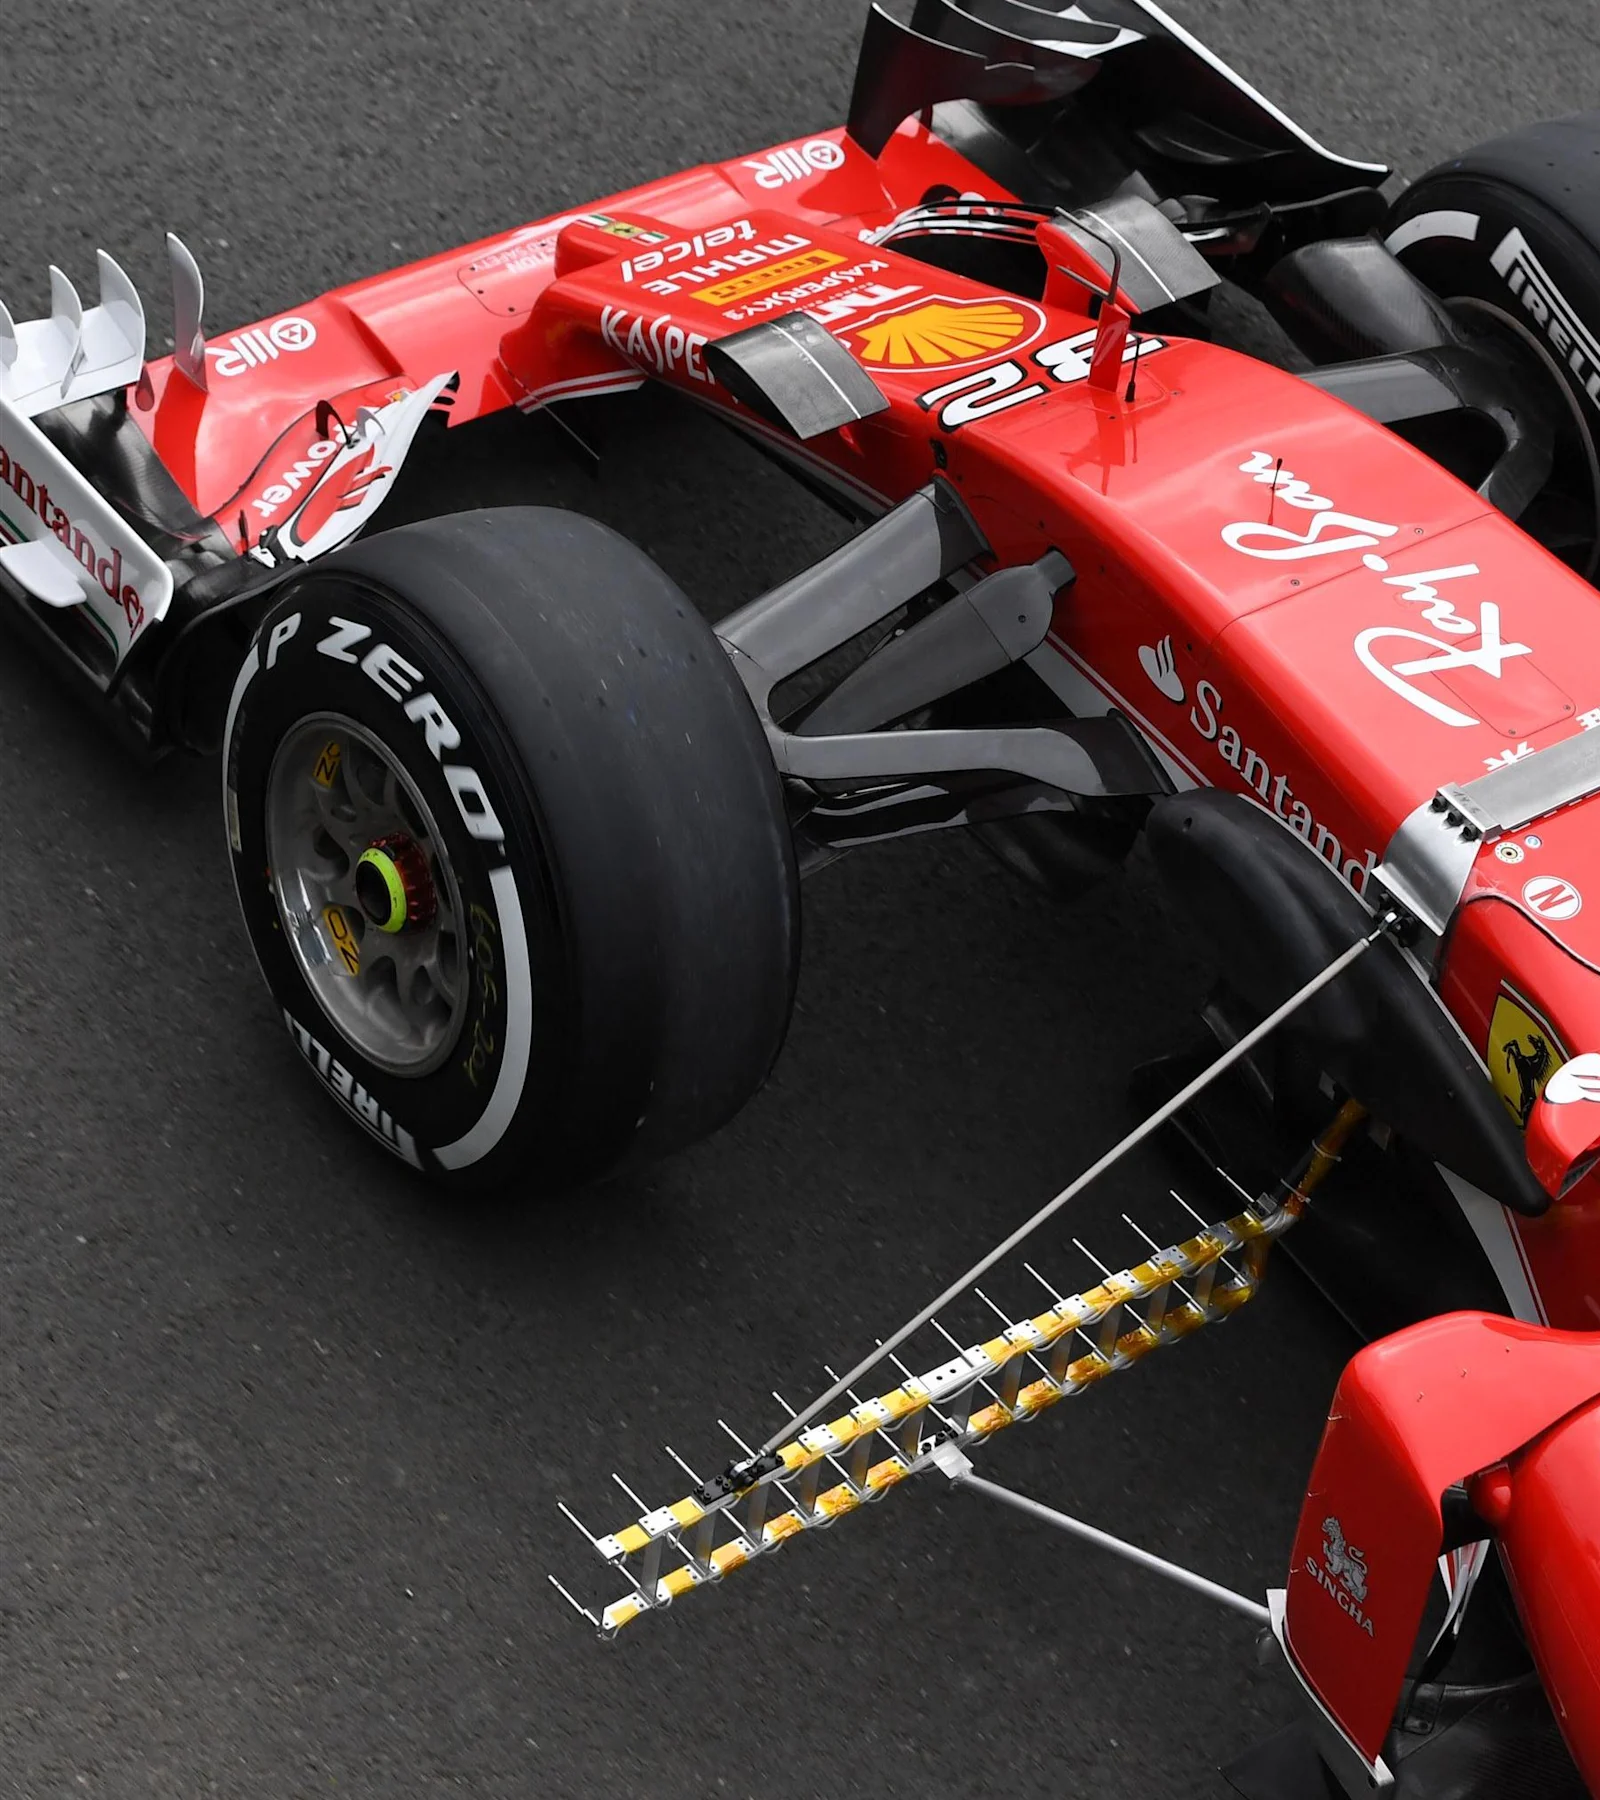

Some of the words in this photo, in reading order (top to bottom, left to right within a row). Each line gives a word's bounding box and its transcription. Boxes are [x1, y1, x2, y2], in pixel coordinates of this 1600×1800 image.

[619, 219, 757, 282] telcel
[641, 234, 812, 296] MAHLE
[740, 259, 890, 319] KASPERSKY
[600, 305, 716, 384] KASPE
[0, 443, 144, 640] antander
[1220, 451, 1533, 727] Ray-Ban
[266, 612, 302, 670] P
[316, 615, 505, 840] ZERO
[1189, 679, 1377, 896] Santand
[283, 1007, 424, 1171] PIRELLI
[1306, 1557, 1374, 1637] SINGHA
